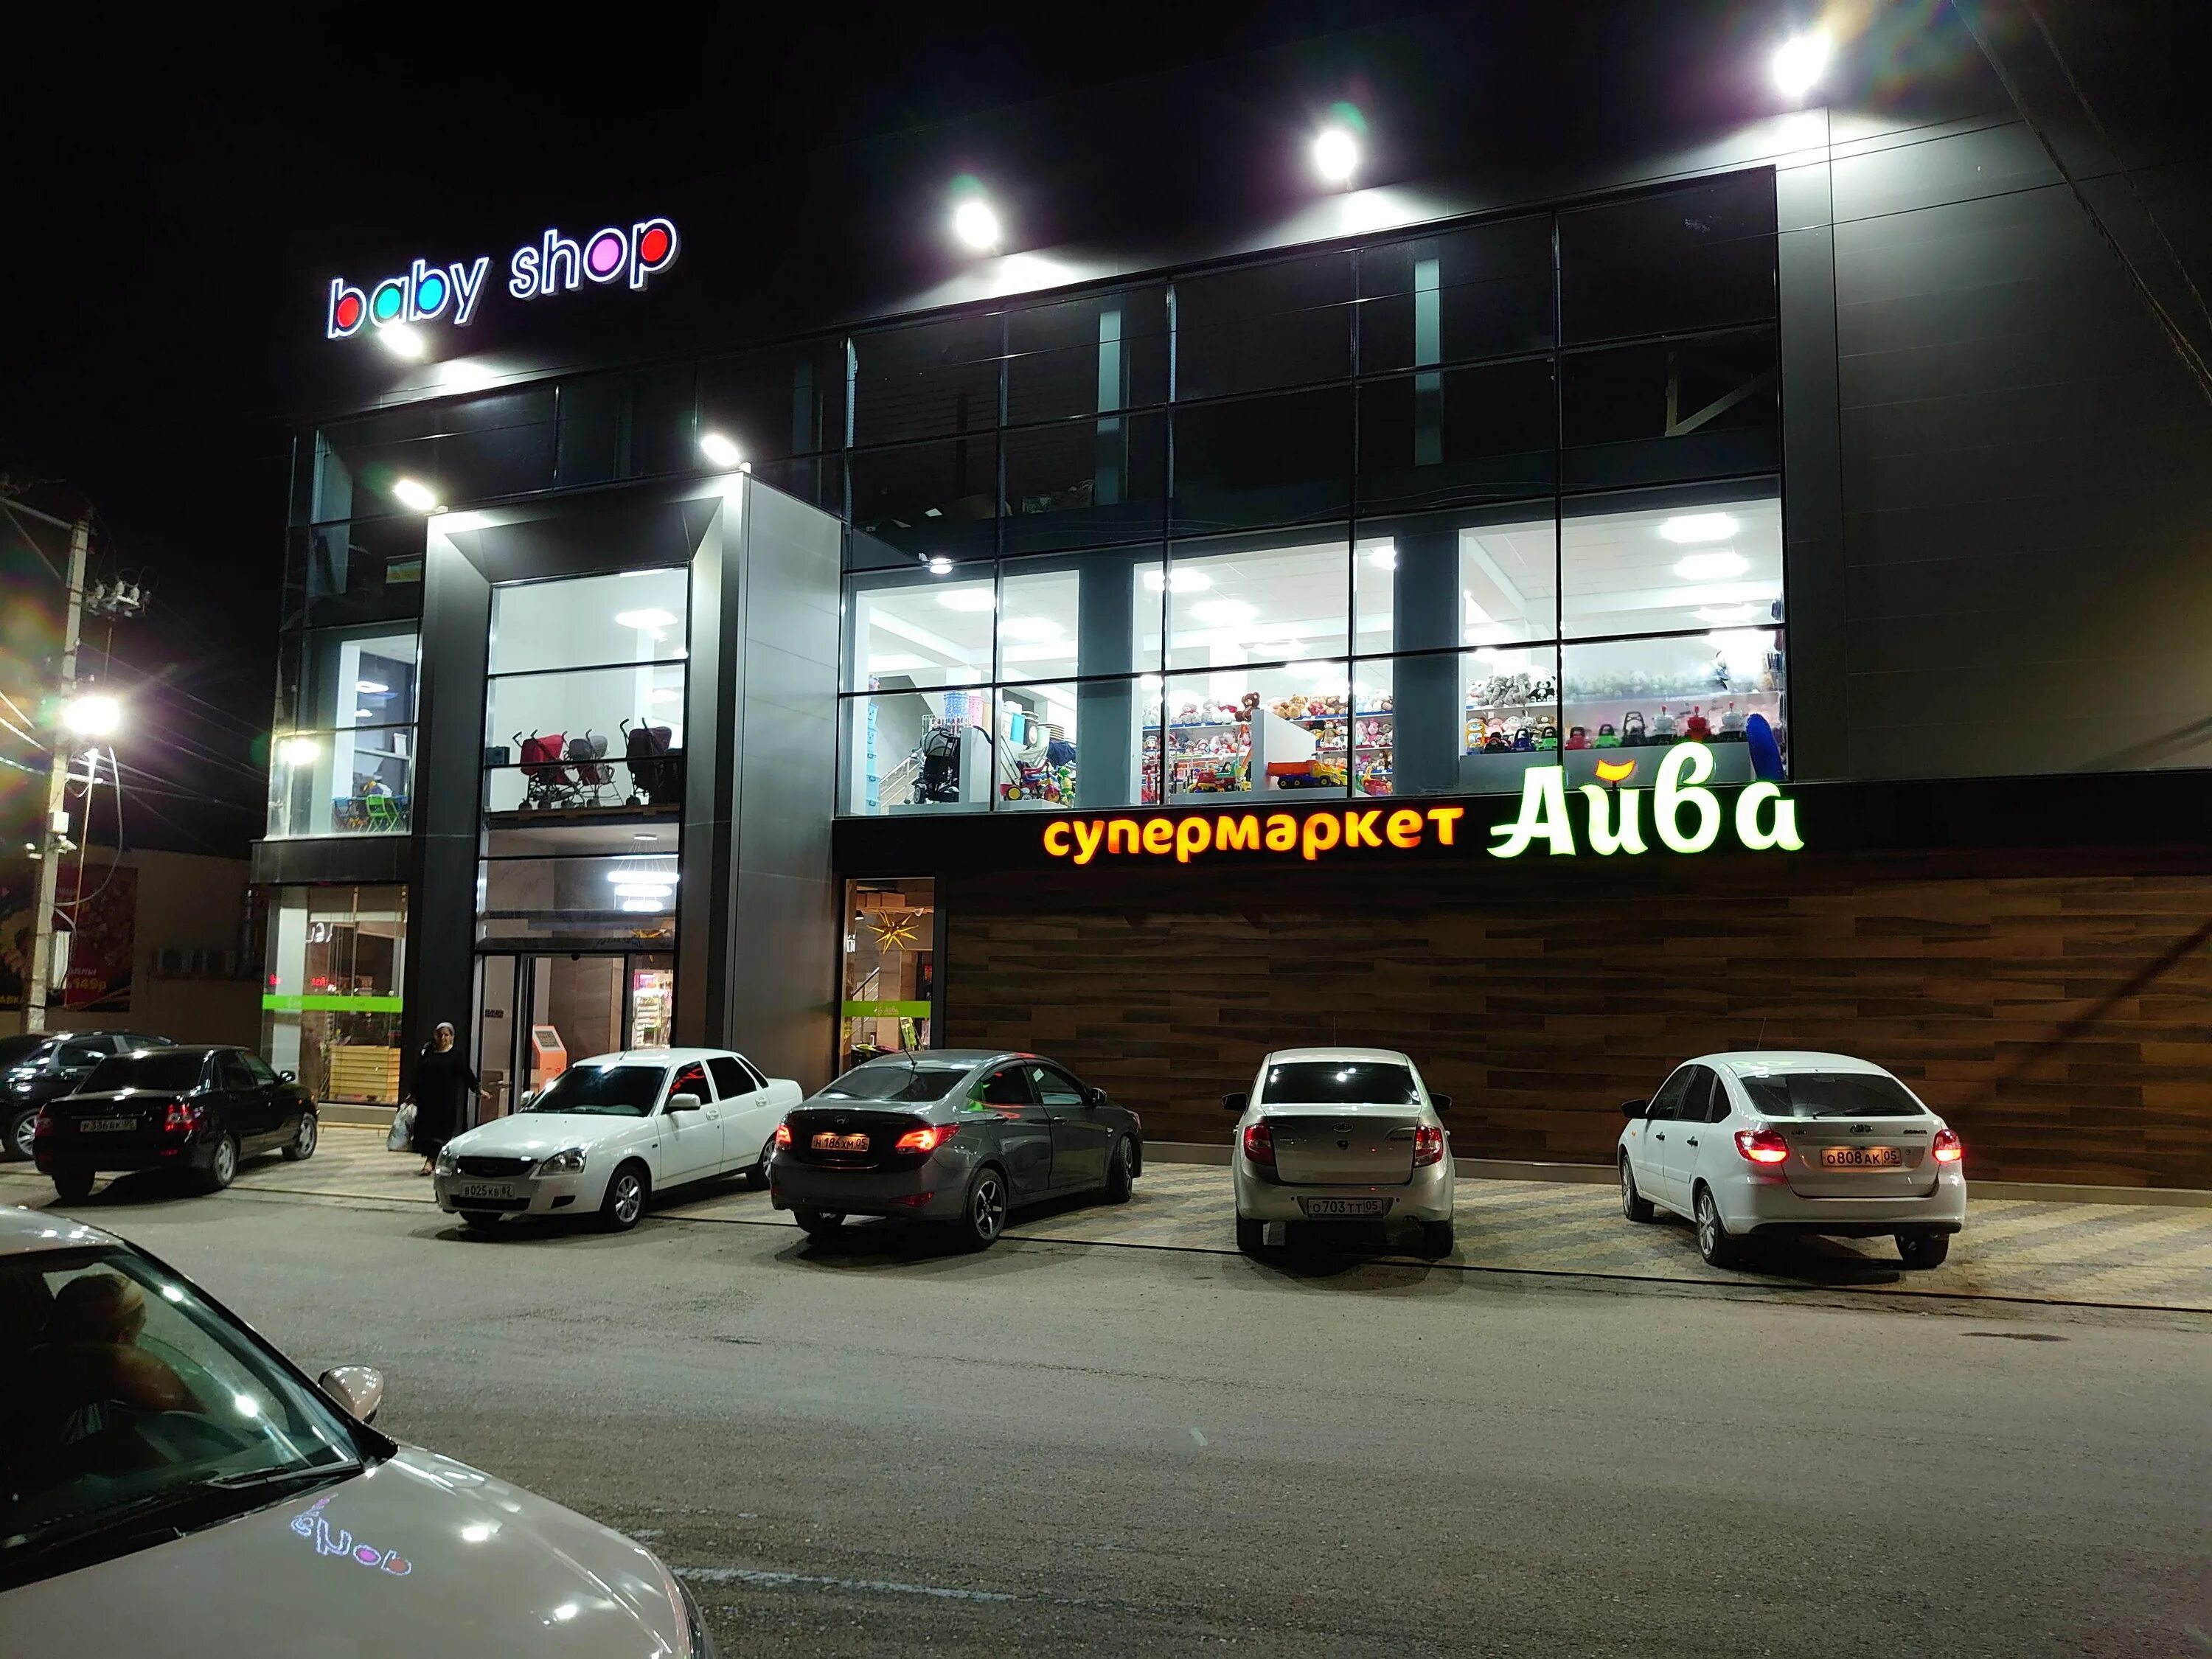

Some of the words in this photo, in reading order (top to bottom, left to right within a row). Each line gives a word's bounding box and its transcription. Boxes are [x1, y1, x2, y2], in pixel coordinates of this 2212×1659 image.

[326, 256, 490, 340] baby
[509, 217, 680, 301] shop
[1043, 804, 1466, 866] супермаркет
[1486, 740, 1806, 859] Айва
[1884, 1150, 1897, 1161] 05
[1365, 1200, 1378, 1211] 05
